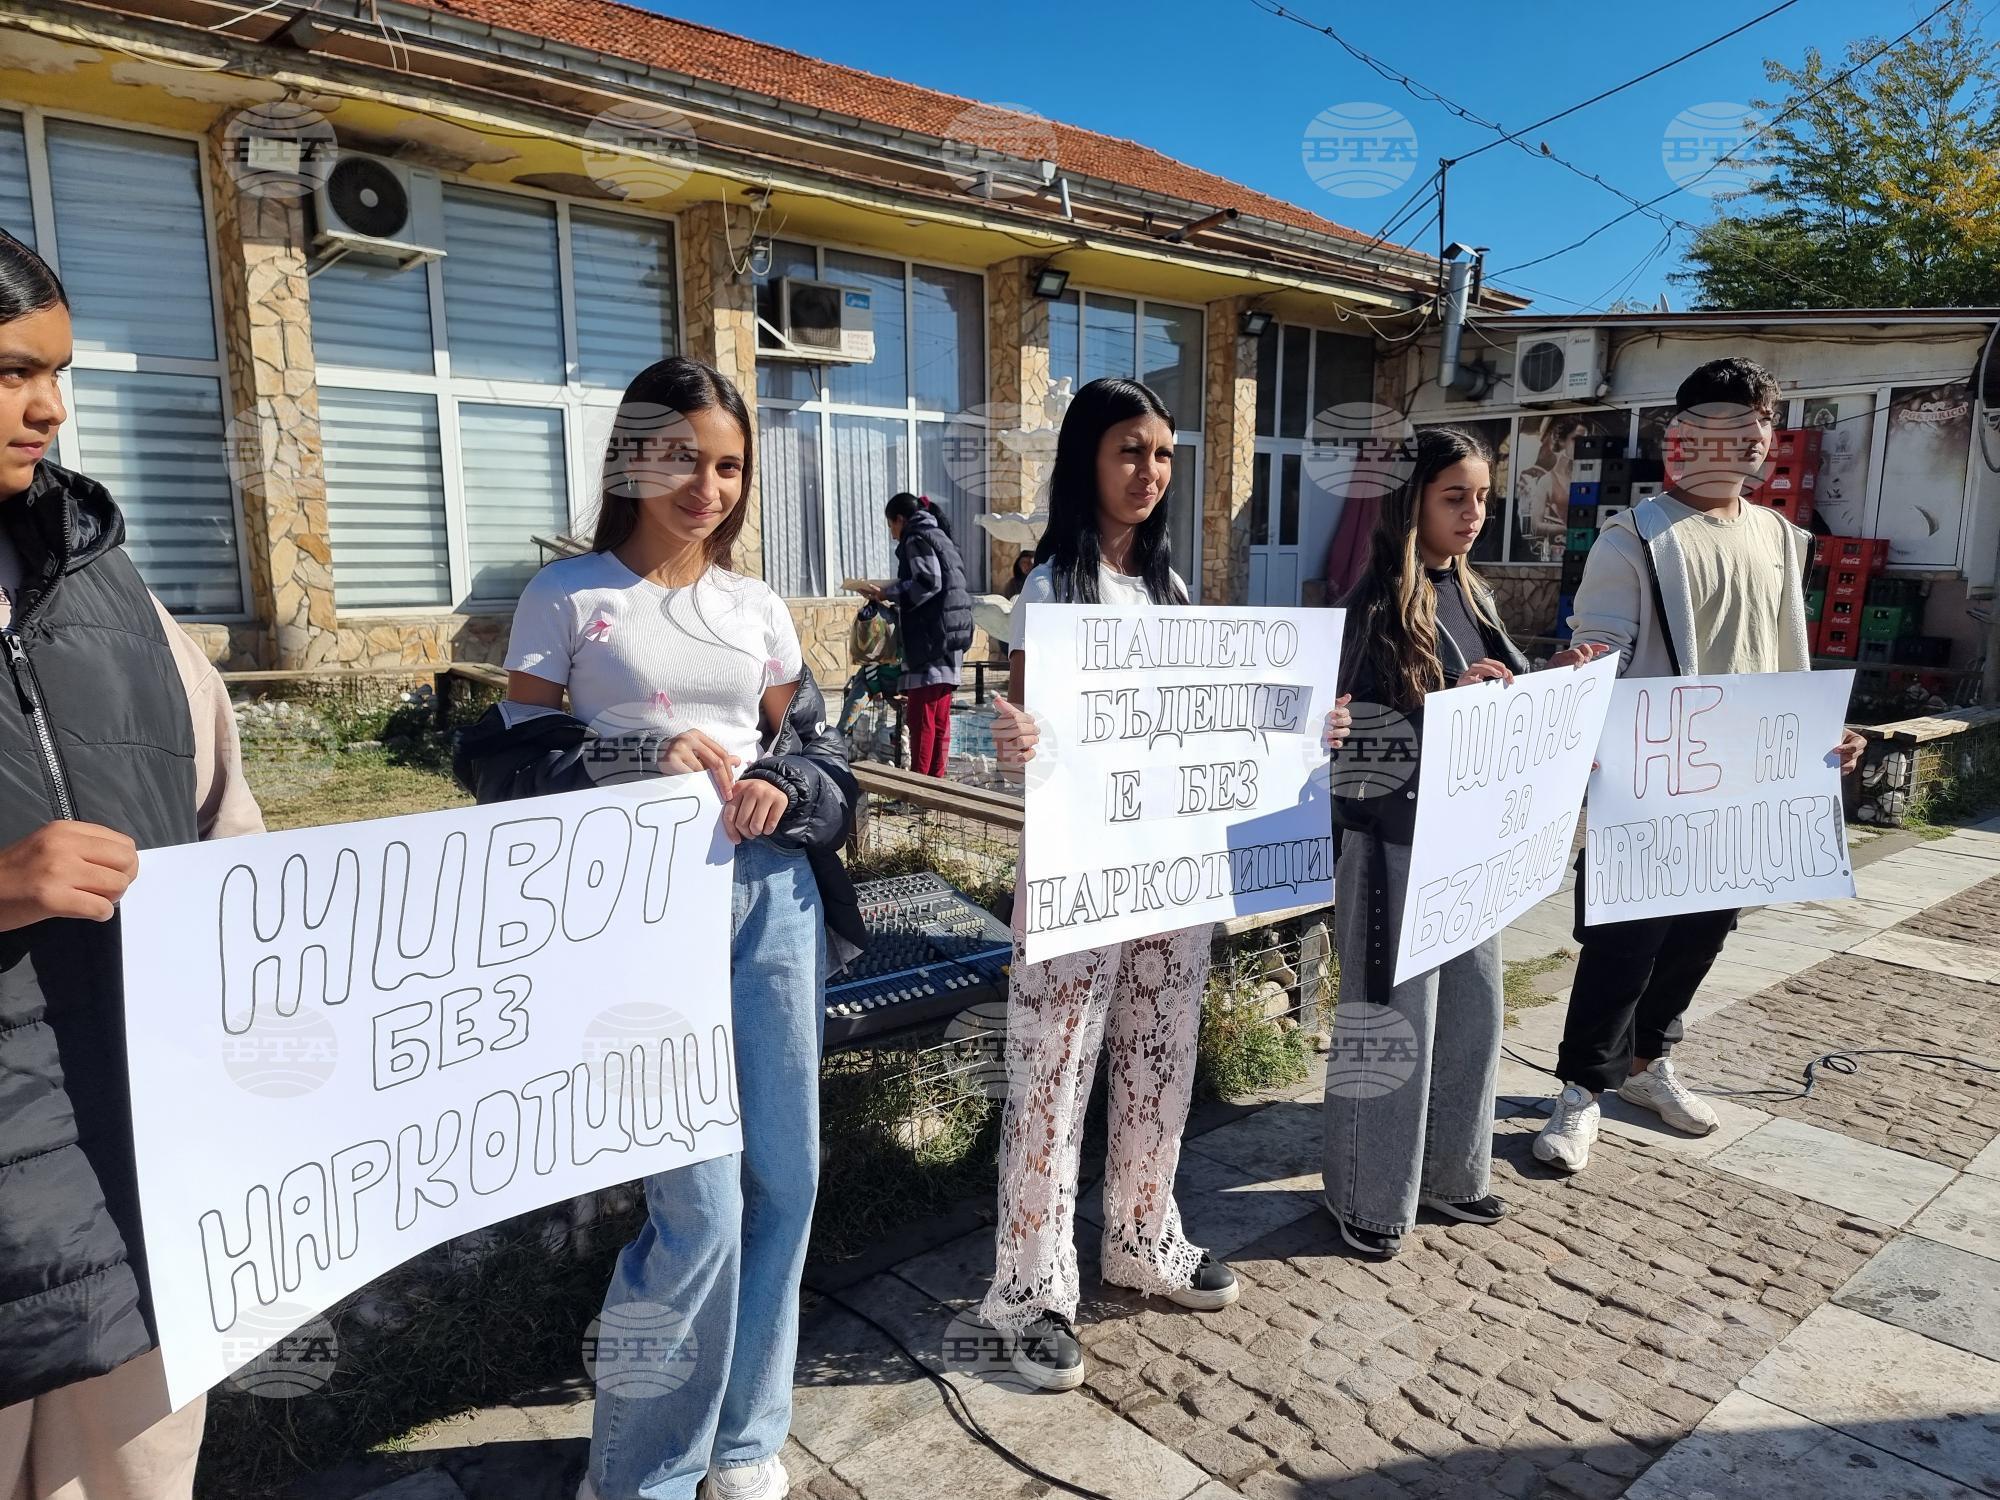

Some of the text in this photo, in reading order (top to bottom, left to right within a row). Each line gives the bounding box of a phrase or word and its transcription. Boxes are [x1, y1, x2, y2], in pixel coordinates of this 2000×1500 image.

[1082, 617, 1299, 671] НАШЕТО
[1081, 683, 1300, 754] БЪДЕЩЕ
[1448, 677, 1597, 798] ШАНС
[1634, 685, 1800, 800] НЕ НА
[1110, 759, 1259, 823] Е БЕЗ
[1498, 784, 1533, 839] ЗА
[219, 796, 701, 1035] ЖИВОТ
[1027, 836, 1333, 935] НАРКОТИЦИ
[1410, 811, 1572, 958] БЪДЕЩЕ
[372, 973, 532, 1091] БЕЗ
[198, 1024, 739, 1333] НАРКОТИЦИ
